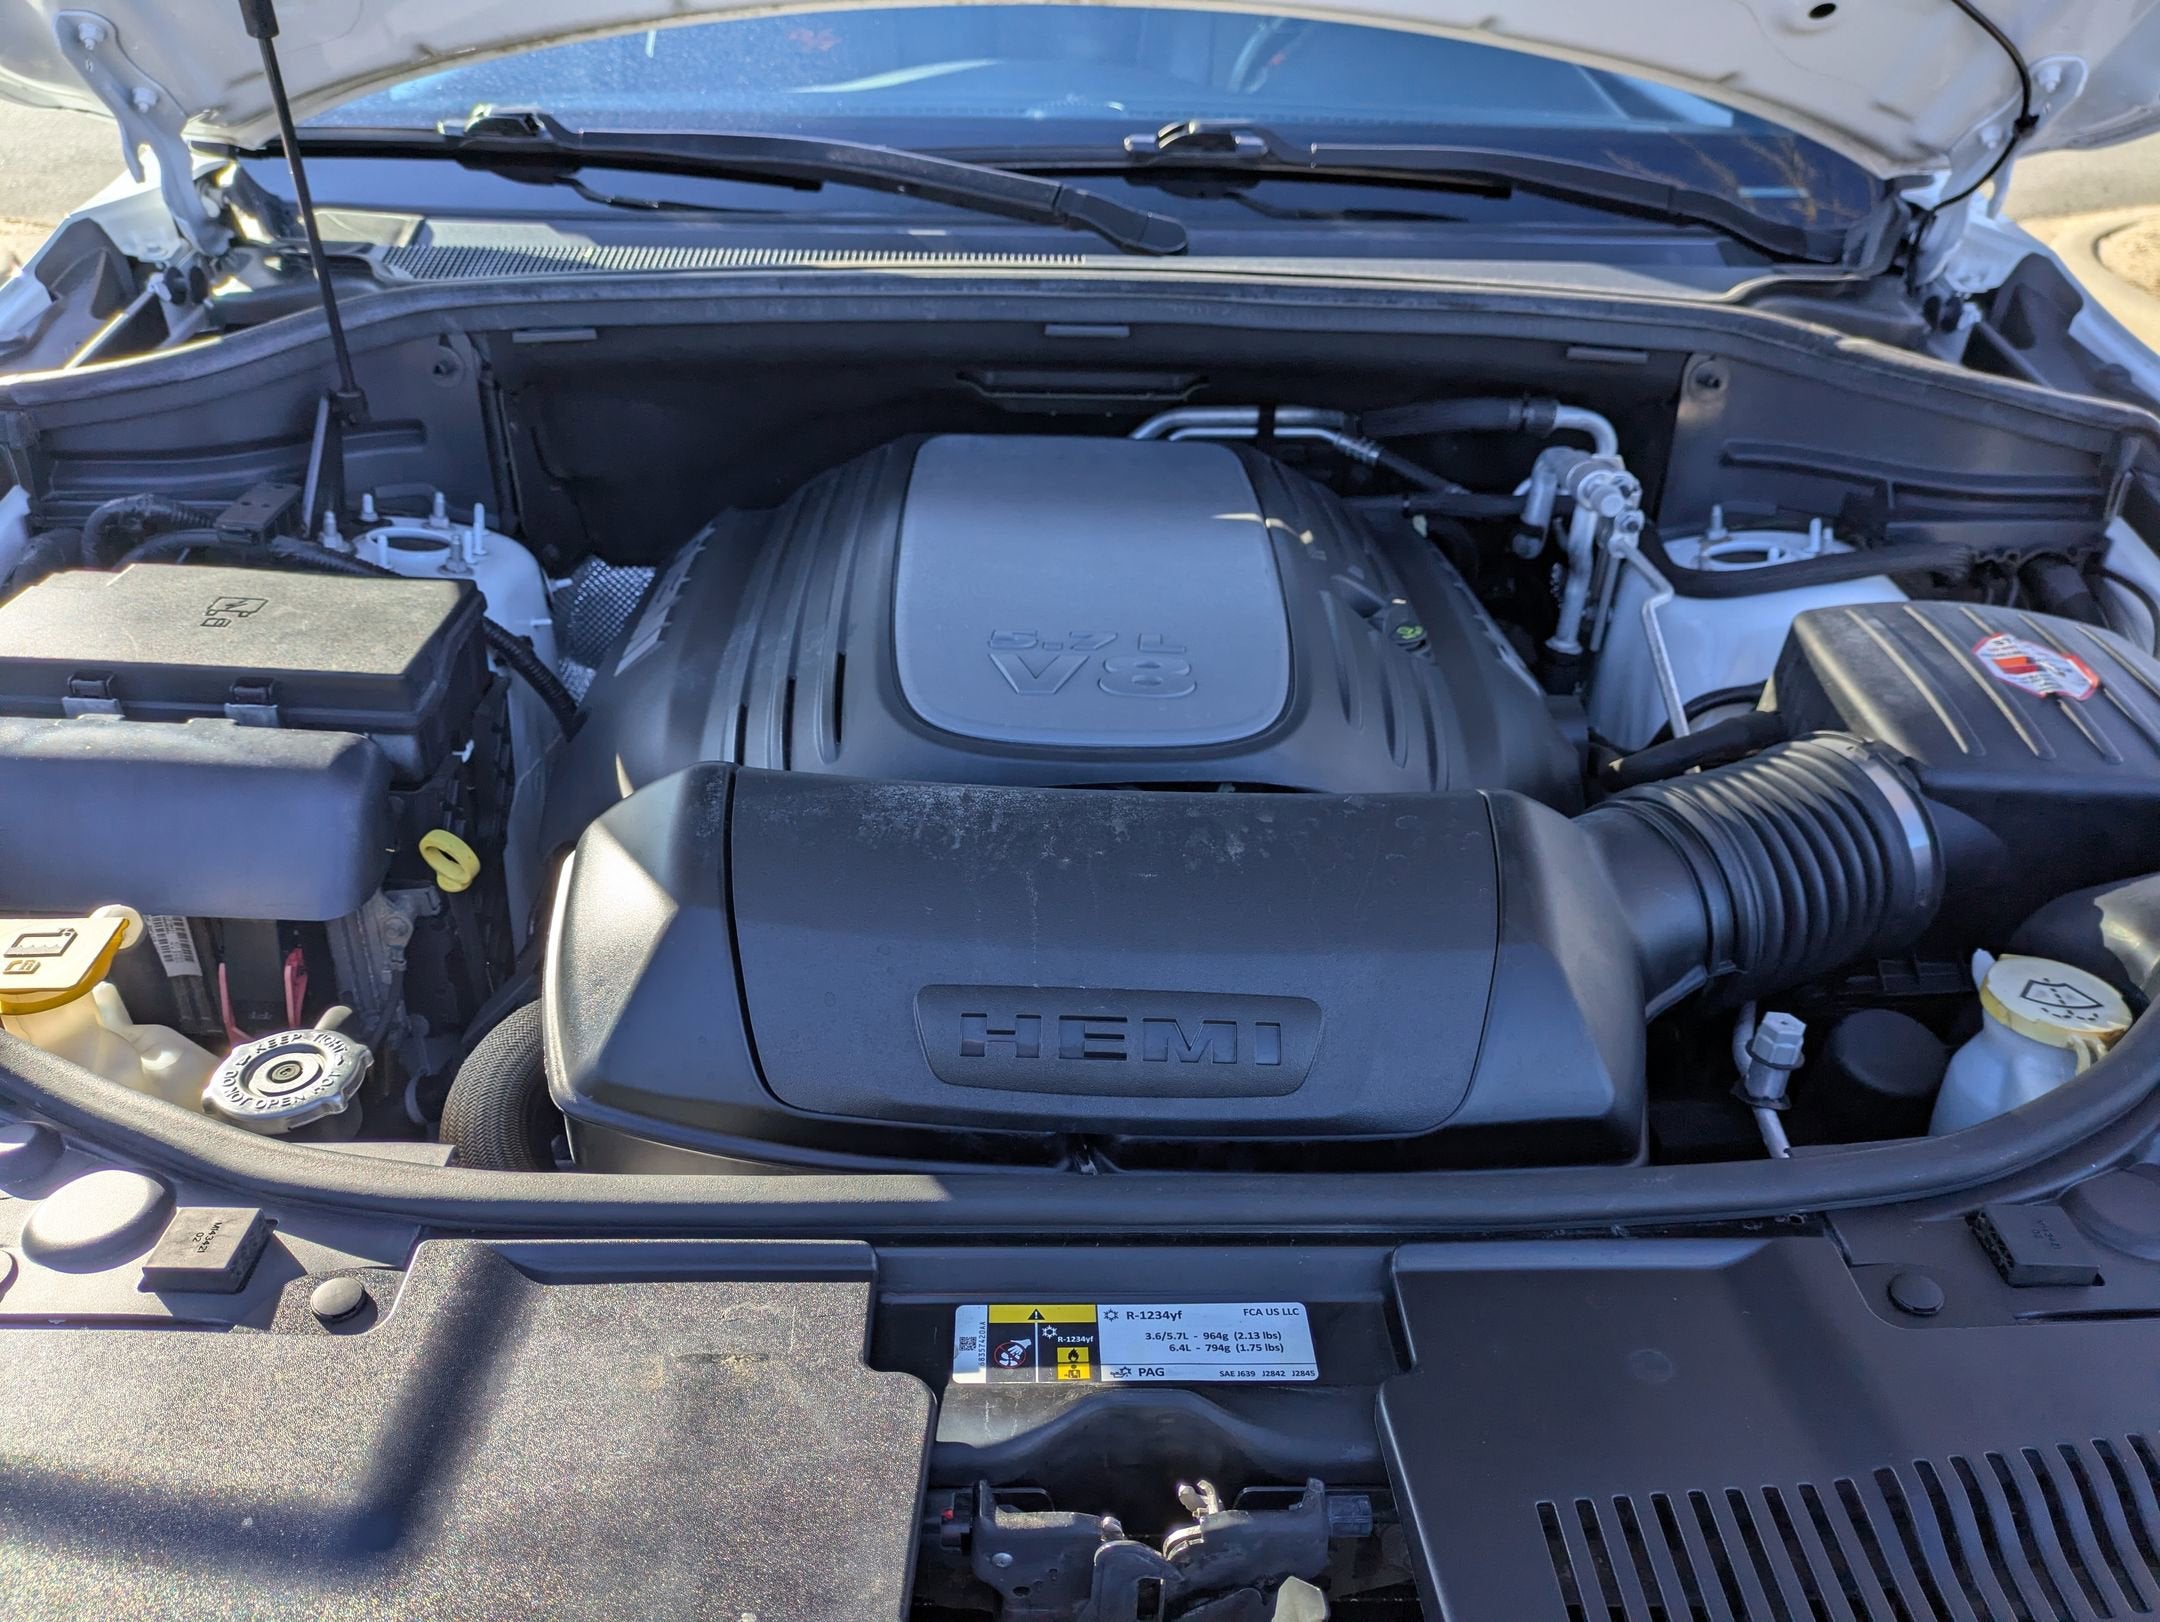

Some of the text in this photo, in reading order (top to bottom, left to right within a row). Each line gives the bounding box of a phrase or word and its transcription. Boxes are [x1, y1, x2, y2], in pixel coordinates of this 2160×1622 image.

[987, 629, 1187, 654] 5.7L
[987, 653, 1198, 699] V8
[256, 1033, 348, 1054] KEEP TIGHT
[960, 1013, 1282, 1065] HEMI
[222, 1071, 239, 1087] DO
[224, 1087, 254, 1106] NOT
[256, 1096, 306, 1110] OPEN
[1126, 1310, 1183, 1321] R-1234yf
[1243, 1308, 1300, 1316] FCA US LLC
[1057, 1335, 1094, 1343] R-1234yf
[1145, 1331, 1189, 1341] 3.6/5.7L
[1203, 1332, 1229, 1341] 964g
[1234, 1331, 1260, 1341] (2.13
[1263, 1331, 1282, 1341] lbs)
[1169, 1344, 1191, 1352] 6.4L
[1205, 1344, 1231, 1353] 794g
[1236, 1343, 1262, 1353] (1.75
[1265, 1343, 1284, 1353] lbs)
[1138, 1367, 1165, 1377] PAG
